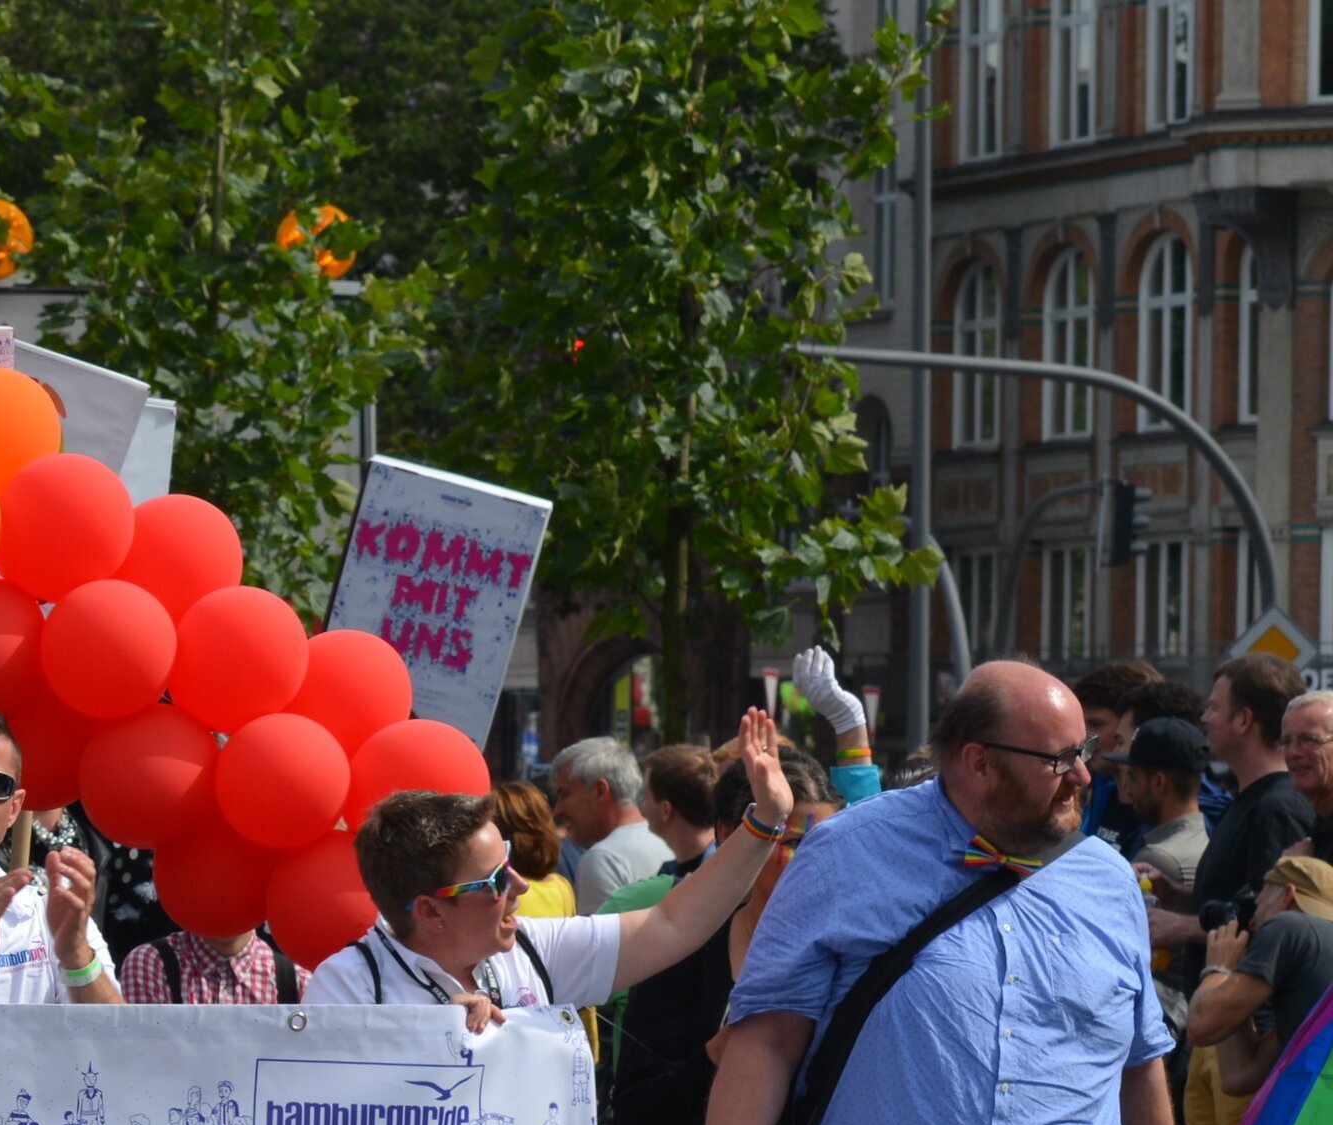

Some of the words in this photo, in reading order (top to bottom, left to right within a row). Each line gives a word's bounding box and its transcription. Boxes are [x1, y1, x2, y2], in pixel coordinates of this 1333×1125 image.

[356, 518, 532, 590] KOMMT
[391, 573, 478, 621] MIT
[381, 616, 474, 671] UNS
